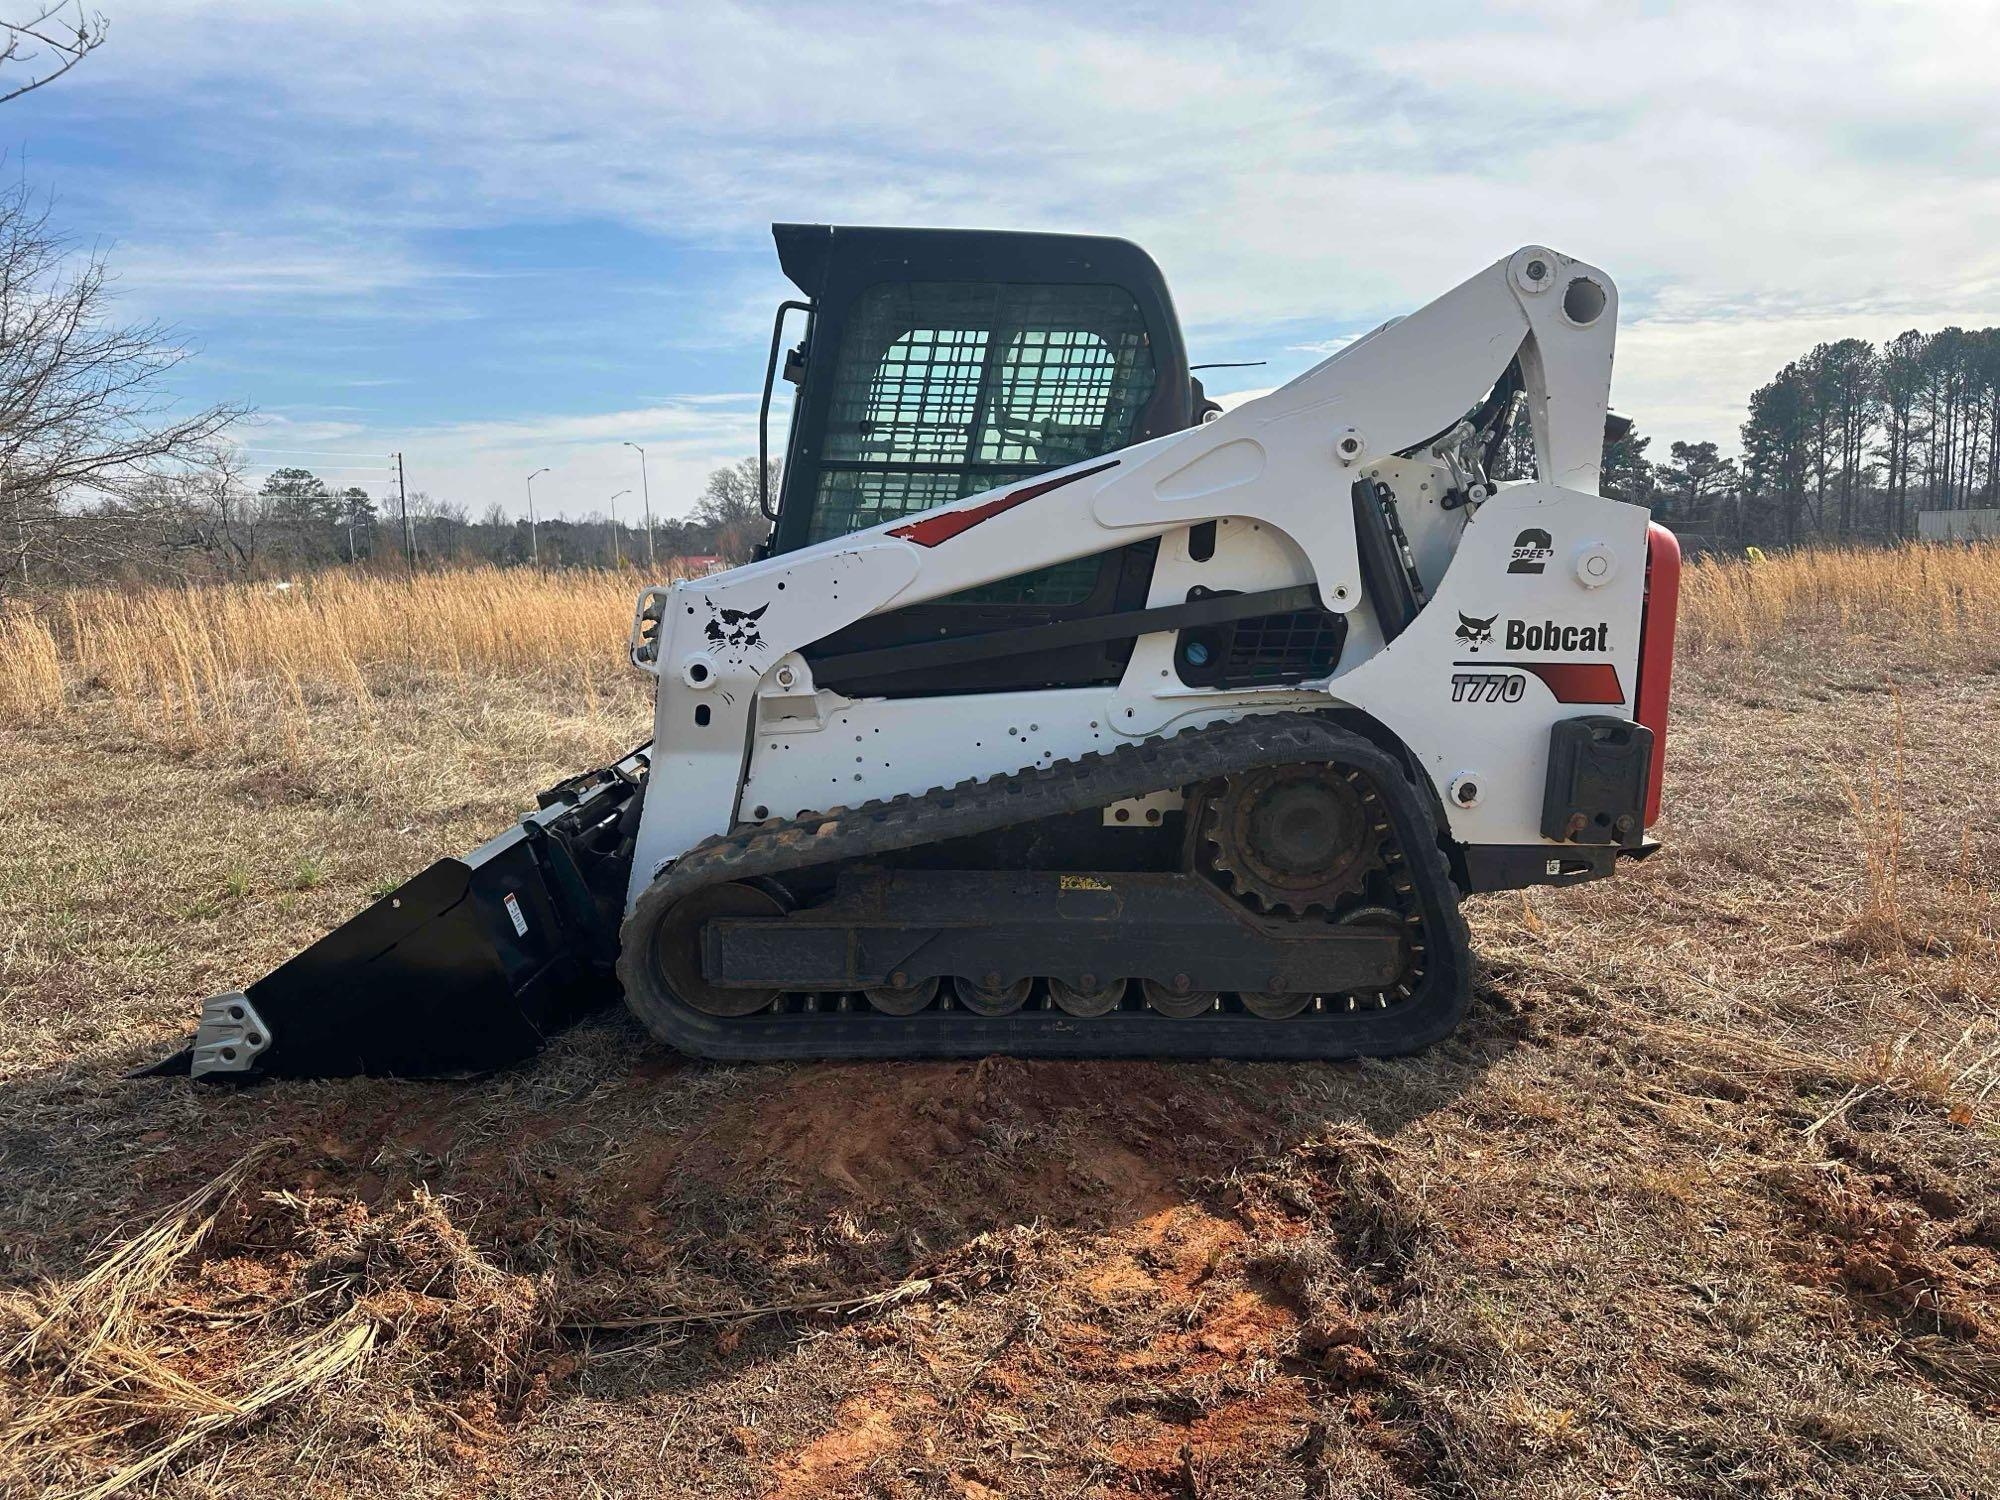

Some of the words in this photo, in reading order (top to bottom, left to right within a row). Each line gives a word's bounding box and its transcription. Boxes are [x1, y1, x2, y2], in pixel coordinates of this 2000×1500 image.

[1507, 528, 1552, 574] 2
[1505, 620, 1608, 652] Bobcat
[1451, 674, 1526, 702] T770
